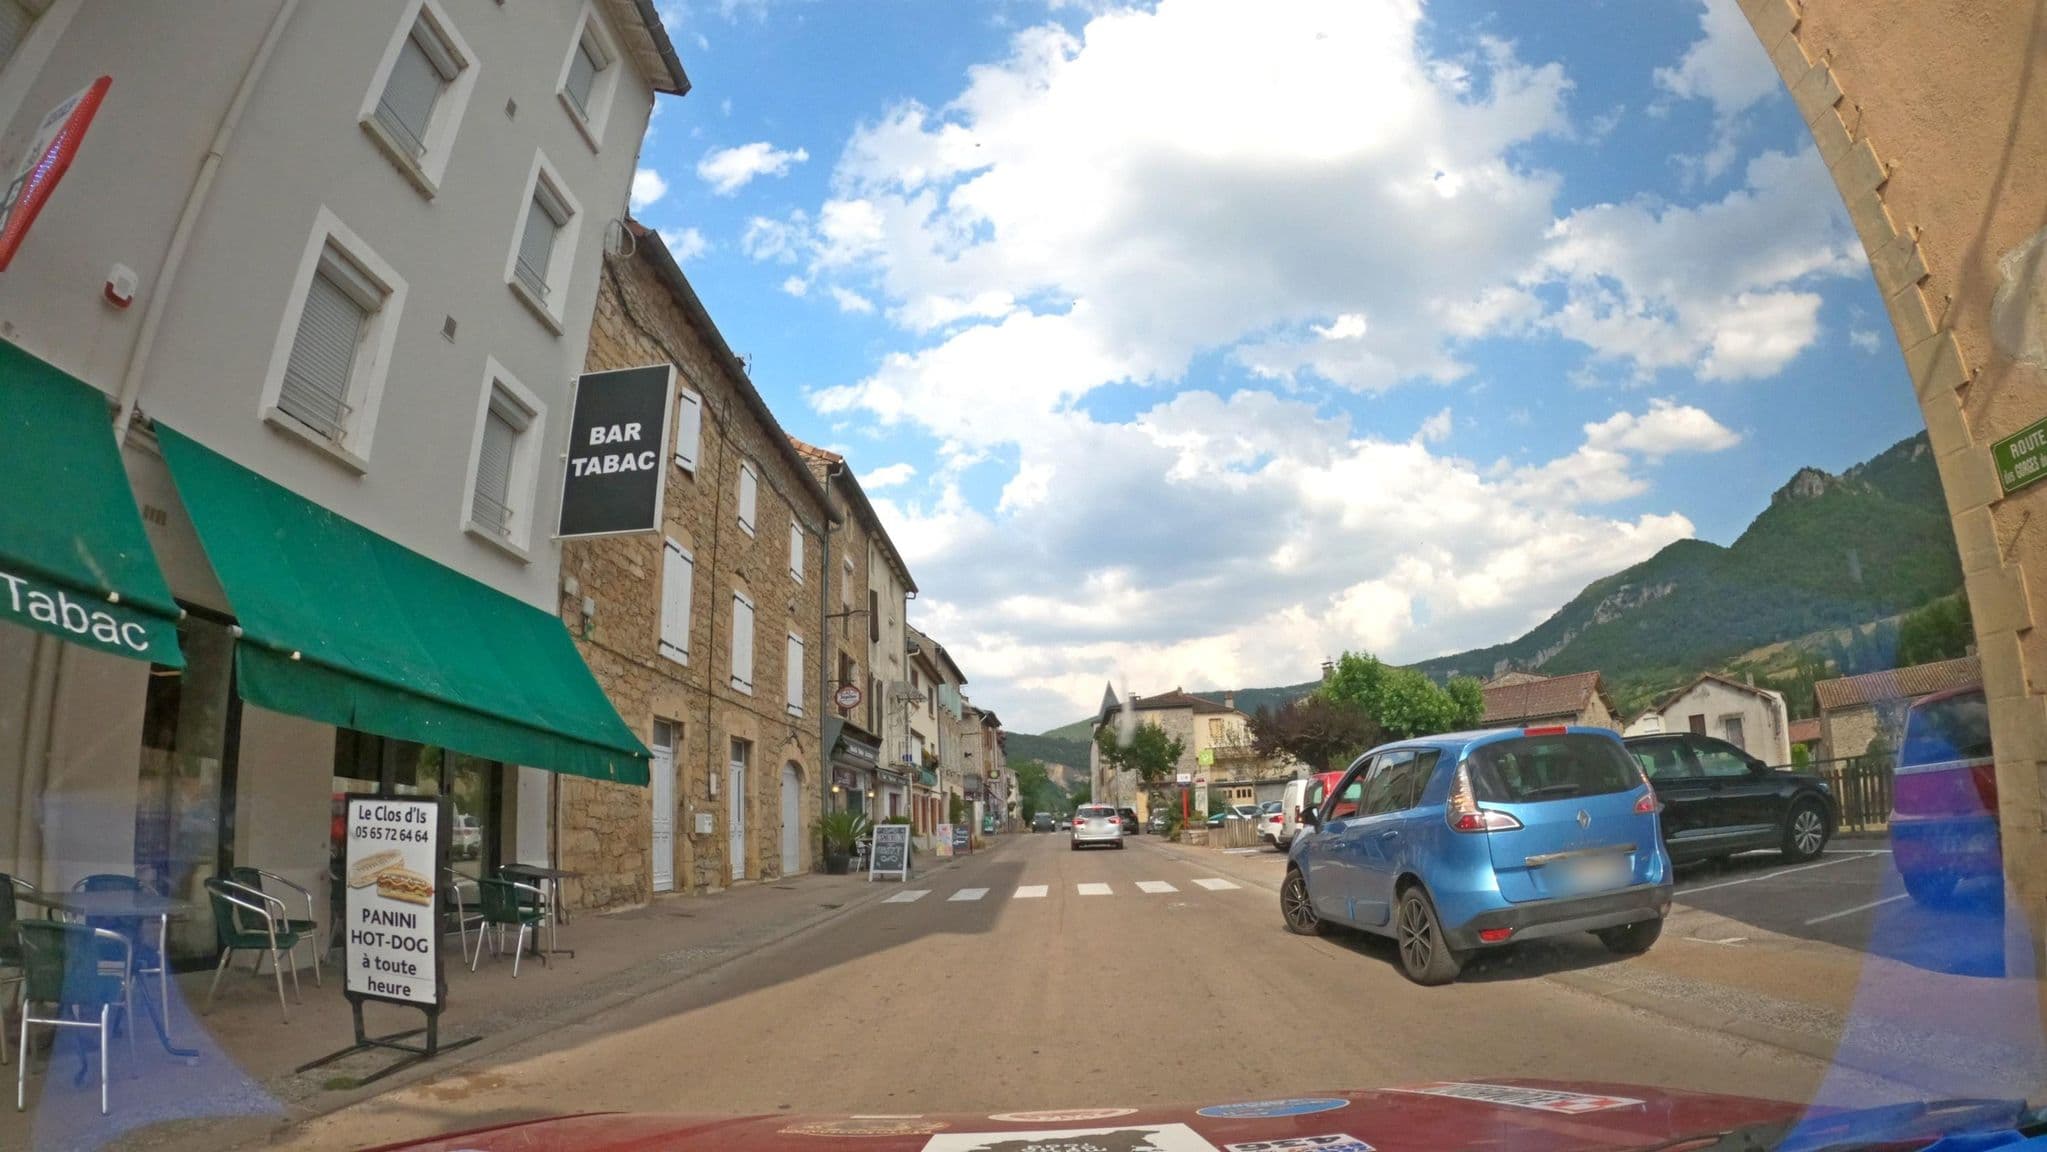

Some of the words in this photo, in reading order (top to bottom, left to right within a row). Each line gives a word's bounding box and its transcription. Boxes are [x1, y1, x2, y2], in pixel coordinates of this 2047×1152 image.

[589, 422, 642, 446] BAR
[2010, 429, 2047, 459] ROUTE
[571, 451, 656, 477] TABAC
[0, 571, 149, 651] Tabac
[359, 805, 371, 820] Le
[375, 805, 401, 822] Clos
[355, 826, 368, 839] 05
[370, 827, 382, 840] 65
[385, 828, 397, 841] 72
[400, 829, 412, 842] 64
[415, 830, 428, 843] 64
[362, 908, 416, 929] PANINI
[351, 929, 428, 953] HOT-DOG
[362, 953, 370, 968] à
[375, 956, 417, 975] toute
[368, 976, 411, 996] heure
